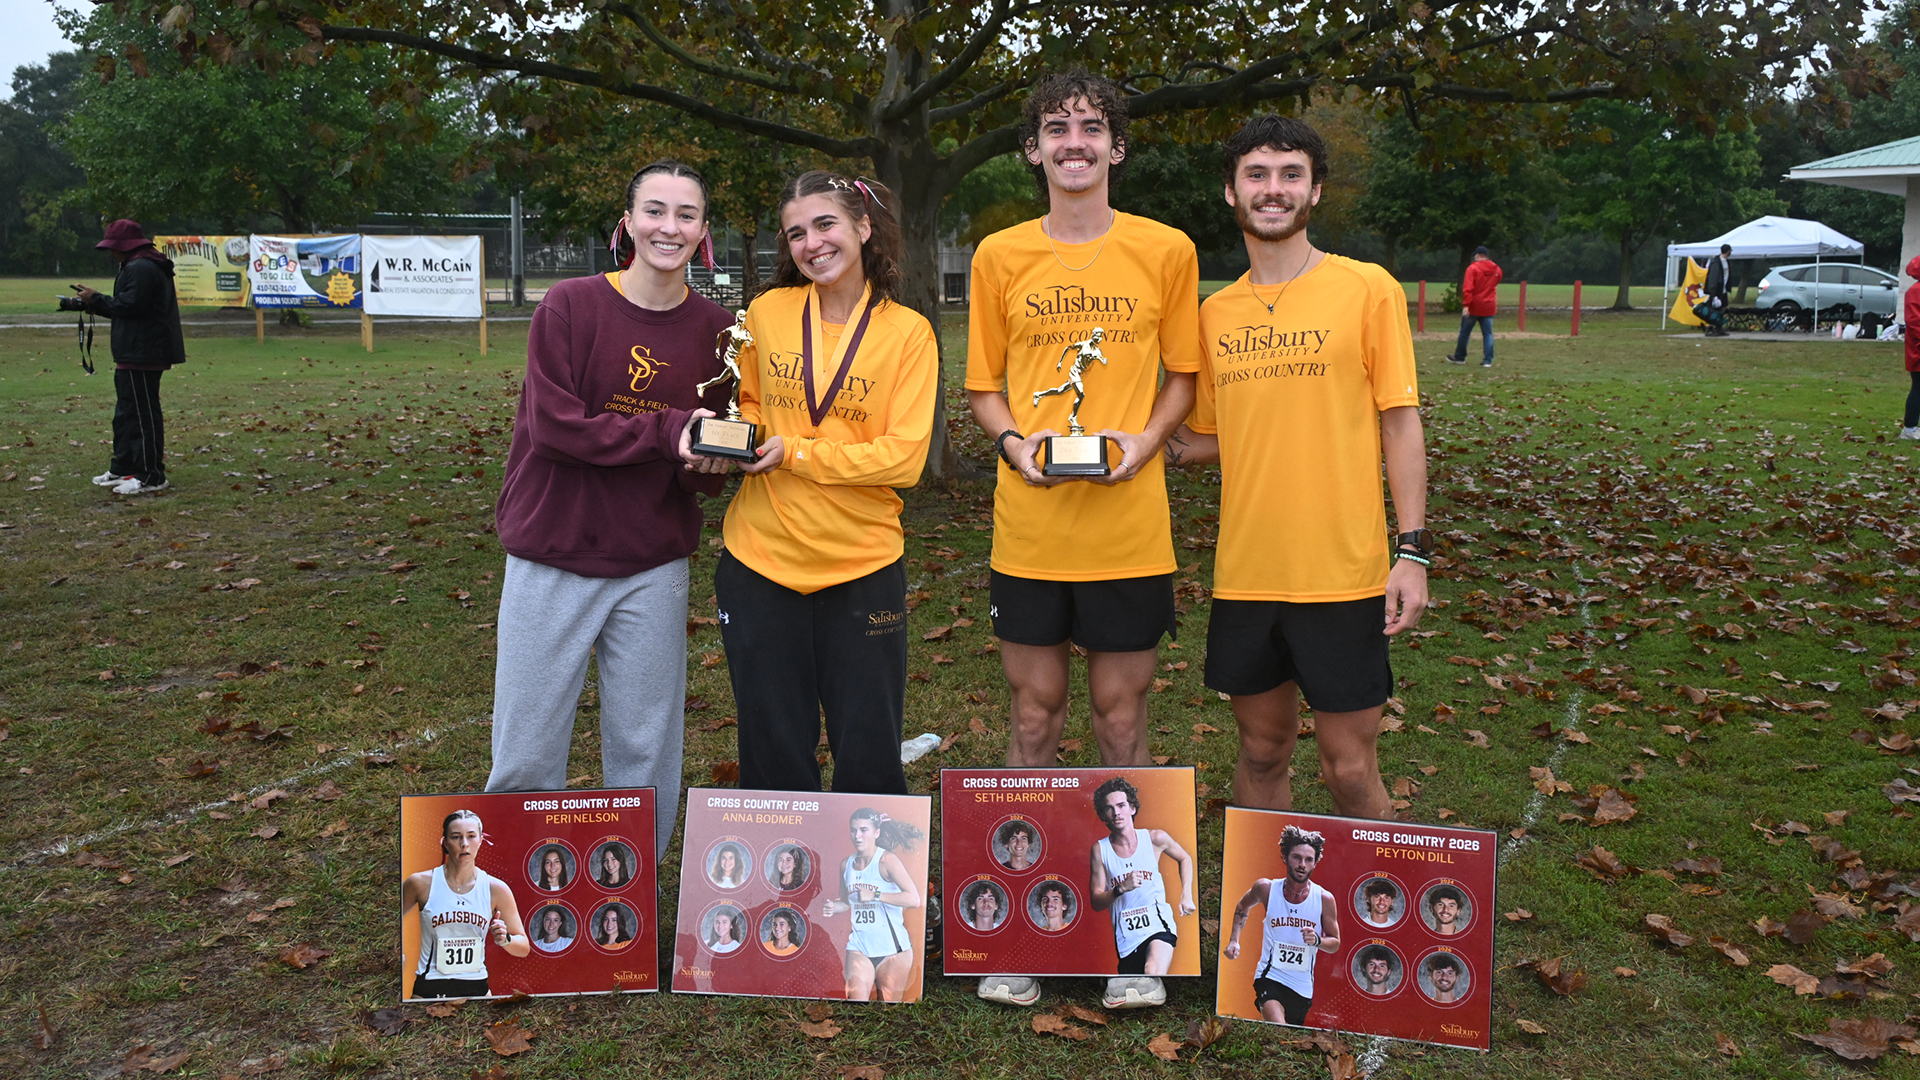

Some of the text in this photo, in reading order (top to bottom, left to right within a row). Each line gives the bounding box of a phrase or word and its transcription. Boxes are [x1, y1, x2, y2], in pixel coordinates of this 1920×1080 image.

[178, 242, 202, 257] SWEET
[202, 243, 211, 260] IT
[211, 244, 219, 267] IS
[254, 254, 297, 272] CUBES
[385, 258, 472, 272] W.R. McCain
[255, 296, 281, 305] PROBLEM
[1026, 286, 1138, 322] Salisbury
[1041, 314, 1123, 326] UNIVERSITY
[1026, 331, 1066, 348] CROSS
[1217, 326, 1330, 358] Salisbury
[1228, 347, 1310, 364] UNIVERSITY
[1216, 363, 1331, 388] CROSS COUNTRY
[775, 379, 857, 402] UNIVTY
[604, 402, 632, 413] CROSS
[612, 394, 669, 410] TRACK & FIELD
[798, 399, 872, 423] CNTRY
[963, 777, 1080, 788] CROSS COUNTRY 2026
[523, 797, 641, 811] CROSS COUNTRY 2026
[707, 797, 819, 811] CROSS COUNTRY 2026
[975, 793, 1054, 803] SETH BARRON
[546, 812, 619, 824] PERI NELSON
[722, 812, 803, 825] ANNA BODMER
[1352, 829, 1480, 851] CROSS COUNTRY 2026
[1376, 847, 1454, 864] PEYTON DILL
[432, 911, 488, 930] SALISBURY
[855, 910, 876, 924] 299
[1125, 914, 1150, 931] 320
[1271, 916, 1317, 928] SALISBURY
[445, 947, 474, 966] 310
[953, 949, 988, 961] Salisbury
[1279, 950, 1303, 965] 324
[613, 970, 650, 981] Salisbury
[1440, 1023, 1480, 1039] Salisbury
